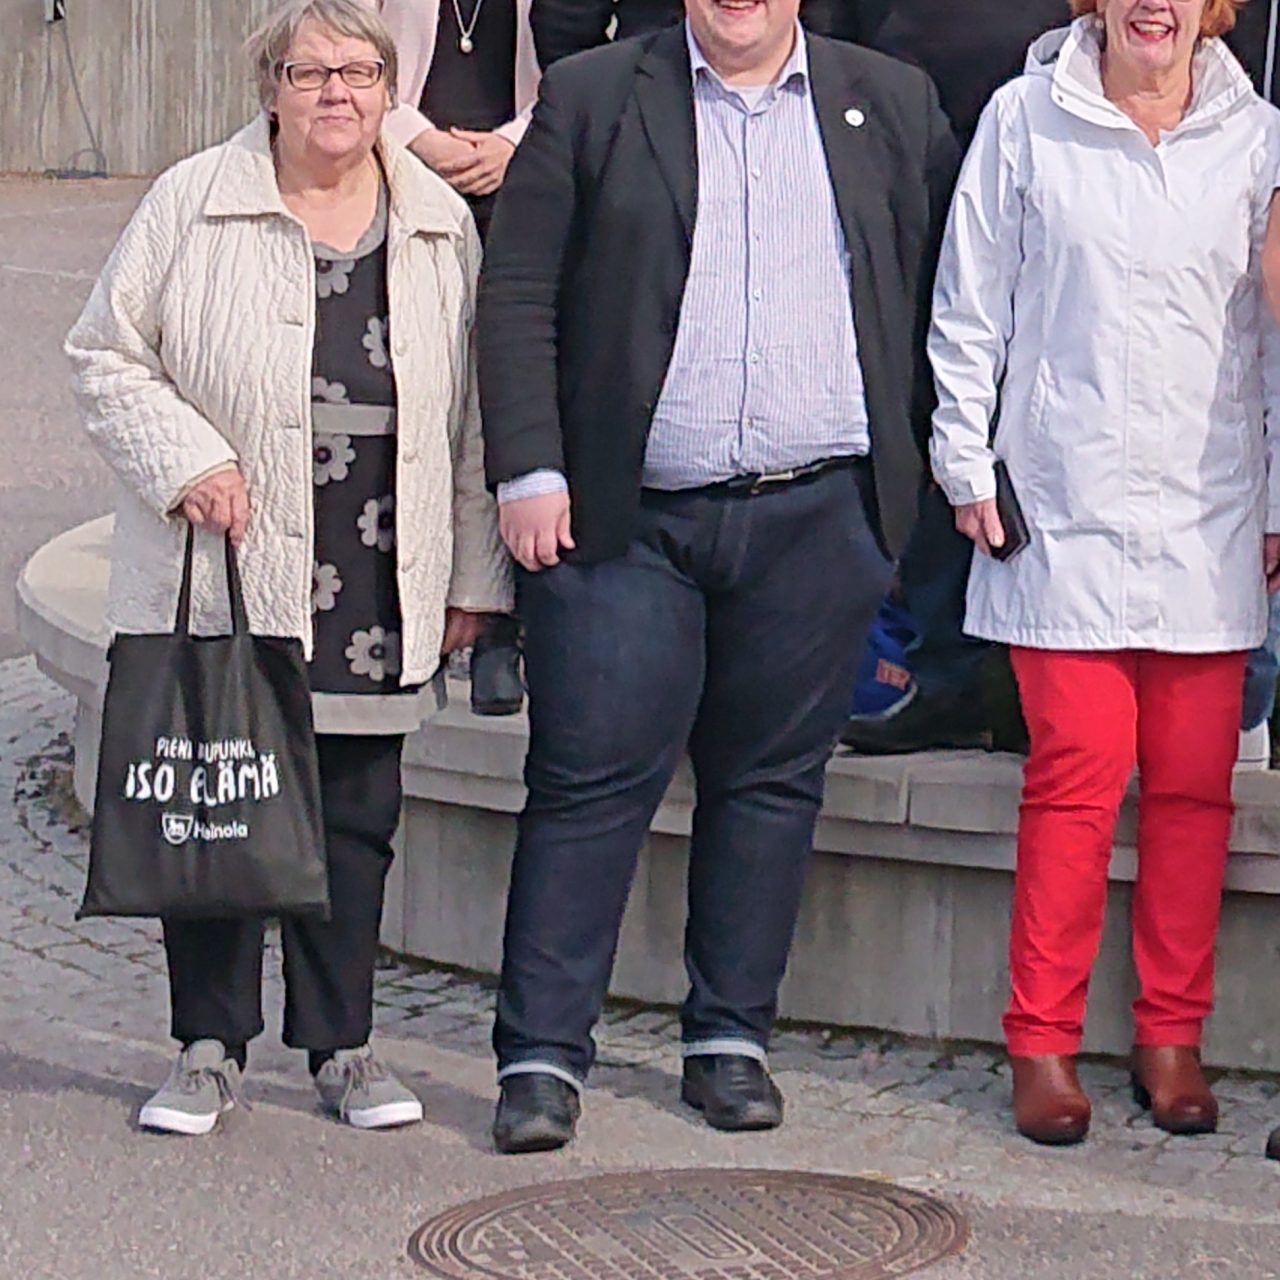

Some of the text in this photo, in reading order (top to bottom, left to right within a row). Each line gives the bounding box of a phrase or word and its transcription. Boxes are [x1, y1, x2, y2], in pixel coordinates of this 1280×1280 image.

[156, 736, 256, 763] PIENI UPUNKI
[125, 761, 175, 802] ISO
[194, 821, 248, 840] Heinola
